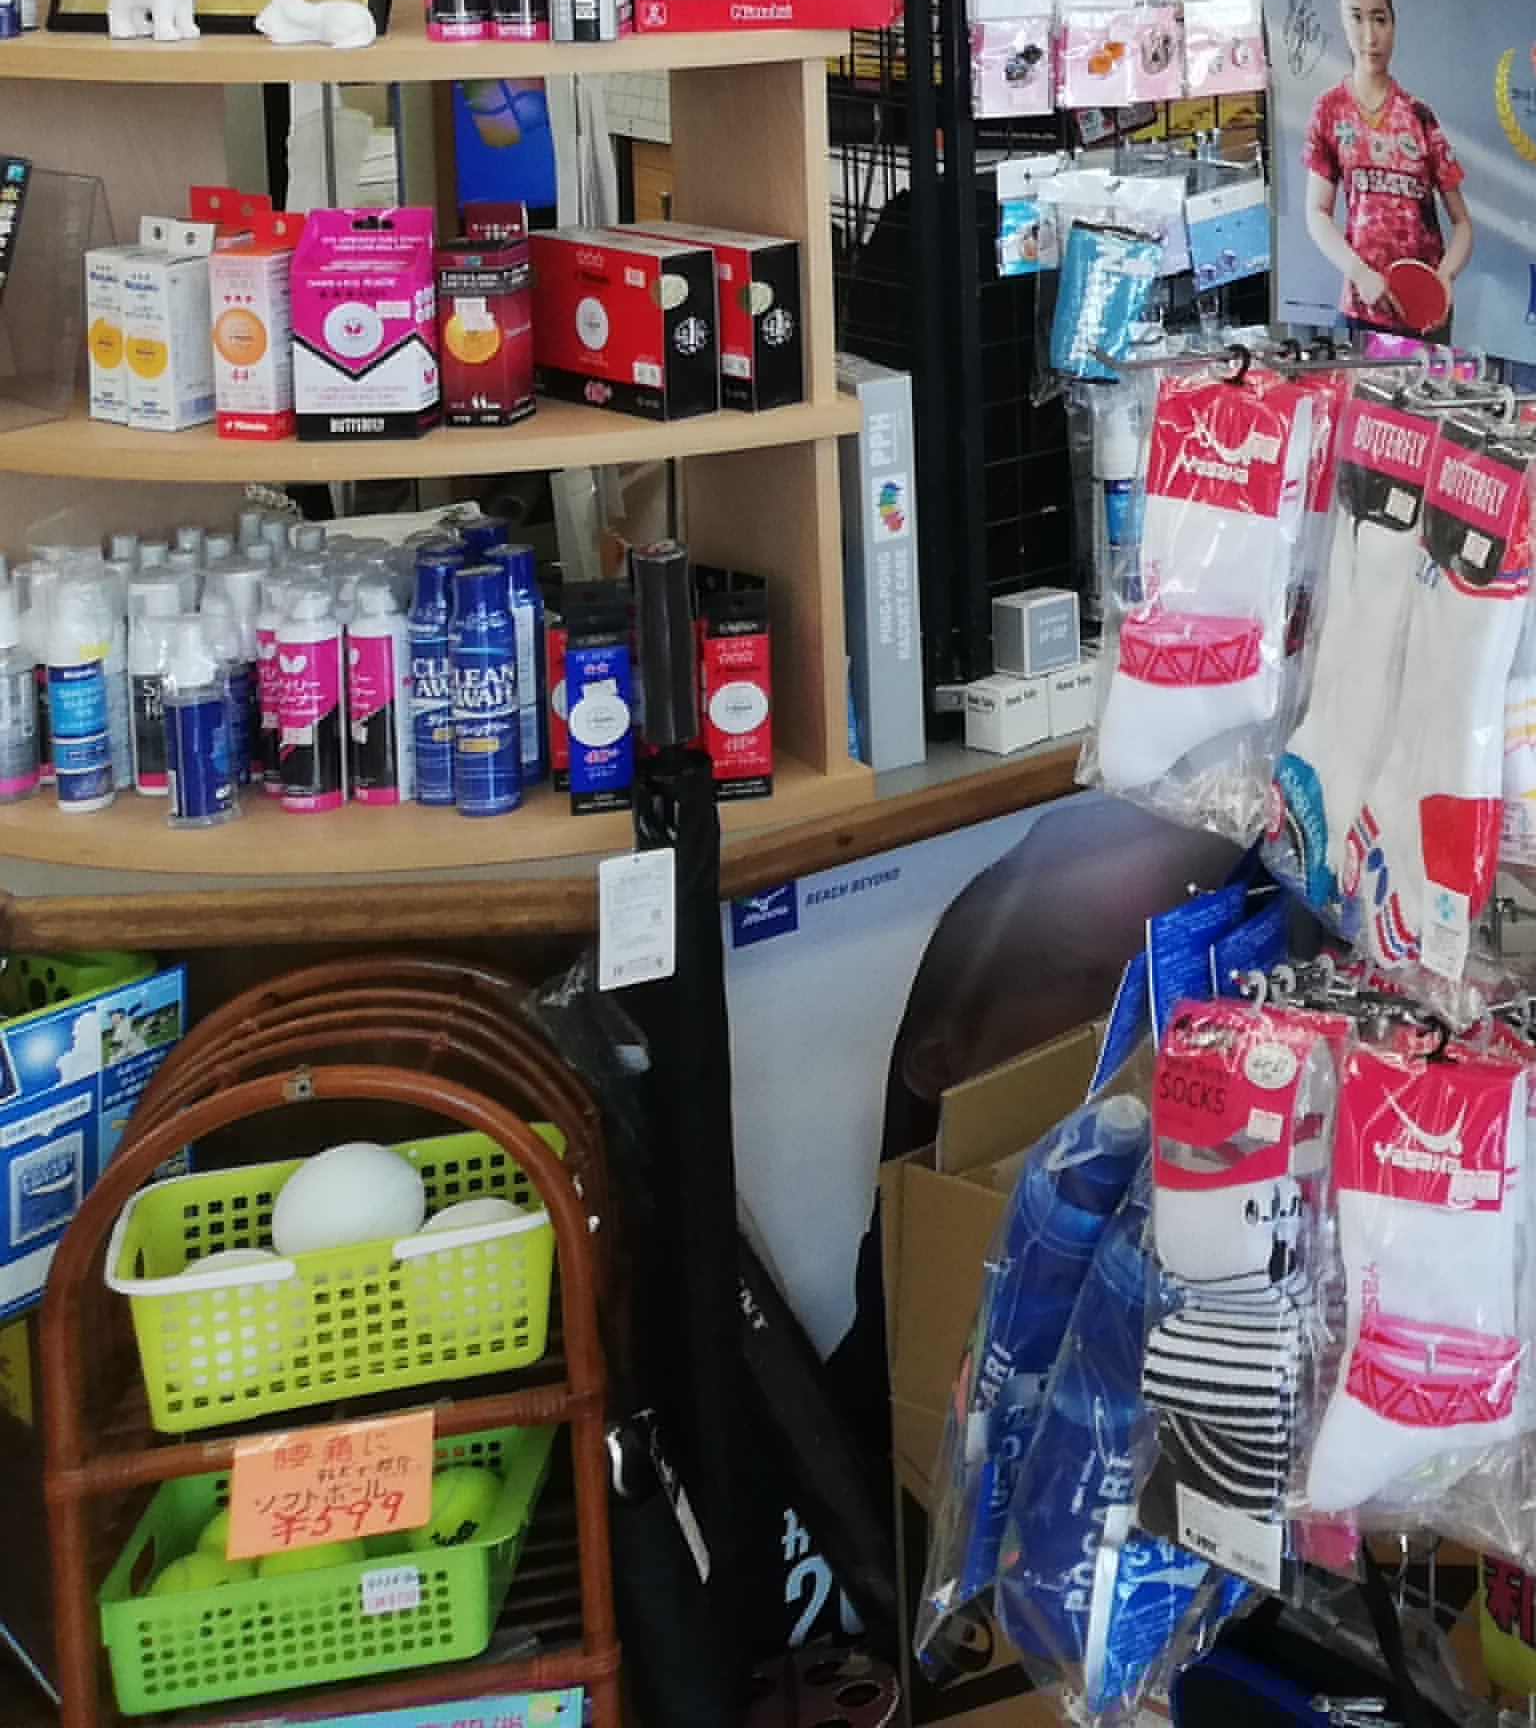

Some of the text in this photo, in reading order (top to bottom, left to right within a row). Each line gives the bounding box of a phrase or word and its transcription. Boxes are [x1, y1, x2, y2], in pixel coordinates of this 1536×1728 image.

[1352, 414, 1430, 469] BUTTERFLY
[1437, 456, 1506, 516] BUTTERFLY
[1159, 1075, 1226, 1115] SOCKS
[255, 1475, 388, 1515] ソフトボール
[271, 1490, 407, 1546] ¥599
